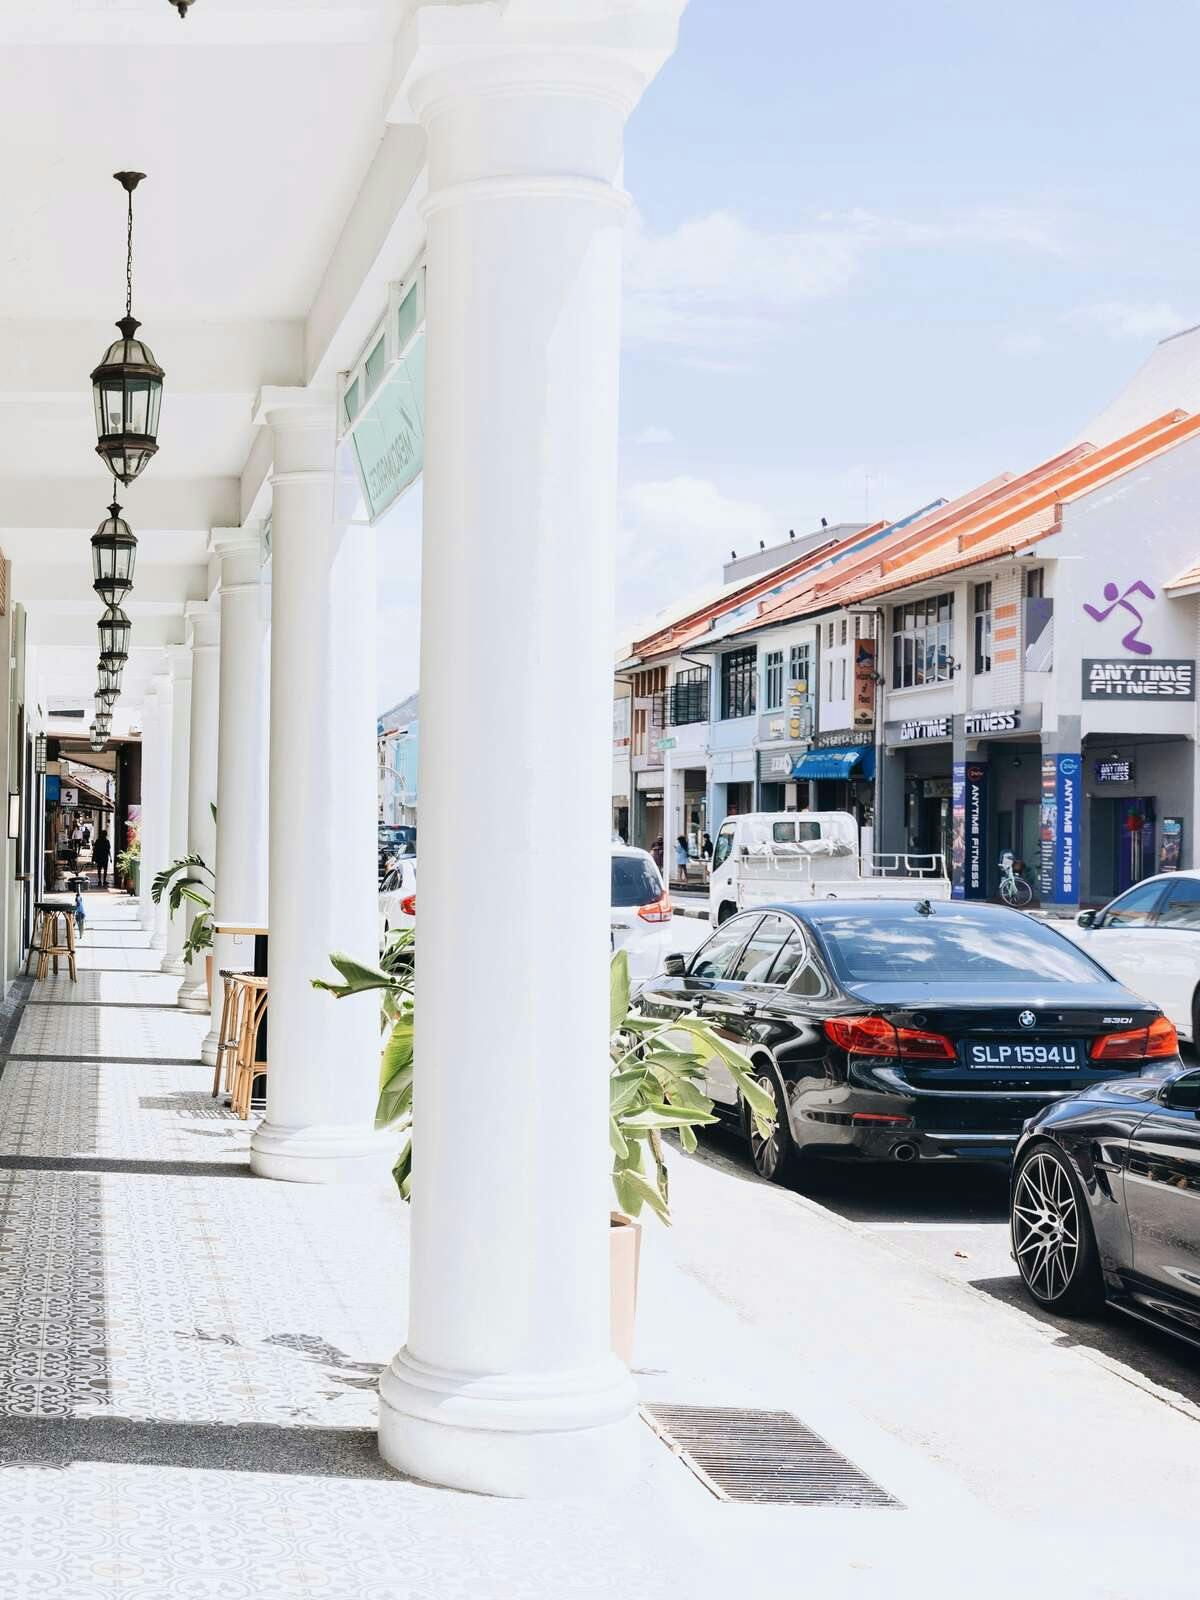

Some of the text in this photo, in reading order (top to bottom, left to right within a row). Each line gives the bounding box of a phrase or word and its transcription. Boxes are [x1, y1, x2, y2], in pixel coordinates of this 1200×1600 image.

[1090, 664, 1191, 681] ANYTIME
[1090, 681, 1191, 694] FITNESS
[900, 710, 1016, 740] ANYTIME FITNESS
[971, 785, 979, 888] ANYTIME FITNESS
[1063, 779, 1073, 892] ANYTIME FITNESS
[972, 1046, 1076, 1063] SLP1594U
